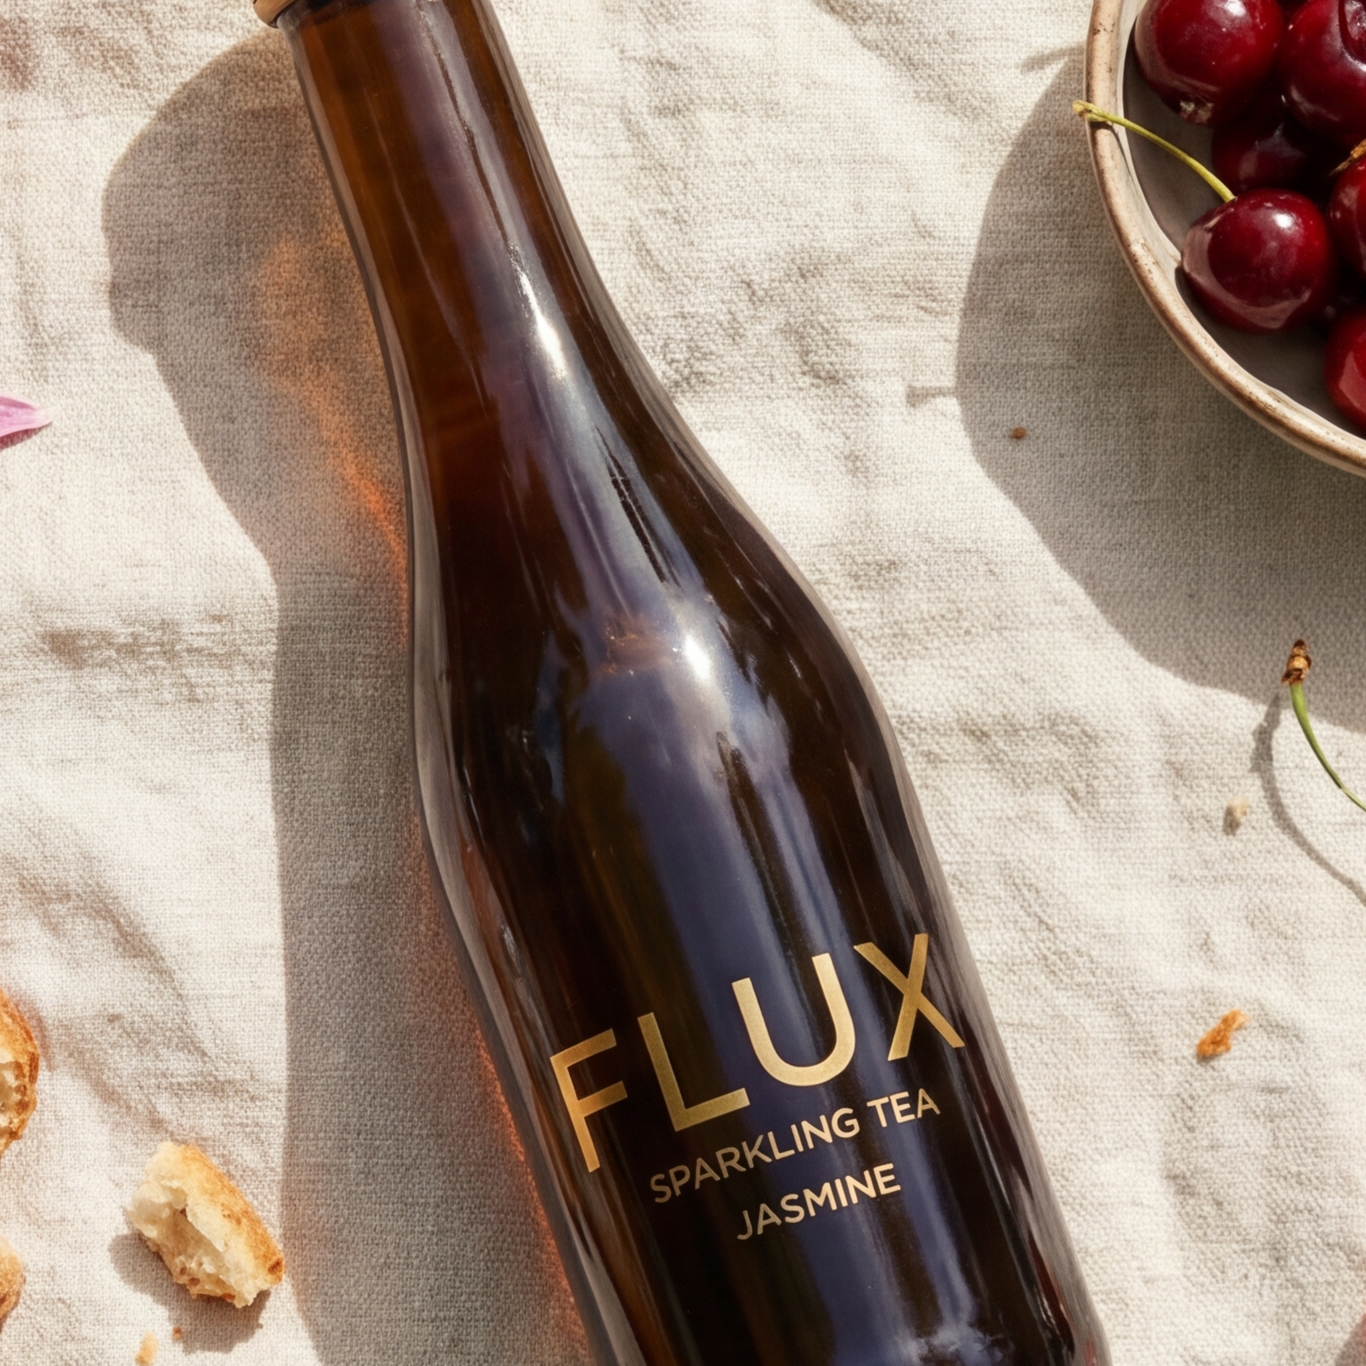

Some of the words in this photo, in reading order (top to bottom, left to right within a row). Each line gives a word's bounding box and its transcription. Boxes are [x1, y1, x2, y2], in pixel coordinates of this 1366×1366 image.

[549, 933, 966, 1174] FLUX
[649, 1107, 862, 1205] SPARKLING
[866, 1087, 941, 1128] TEA
[735, 1162, 902, 1241] JASMINE
